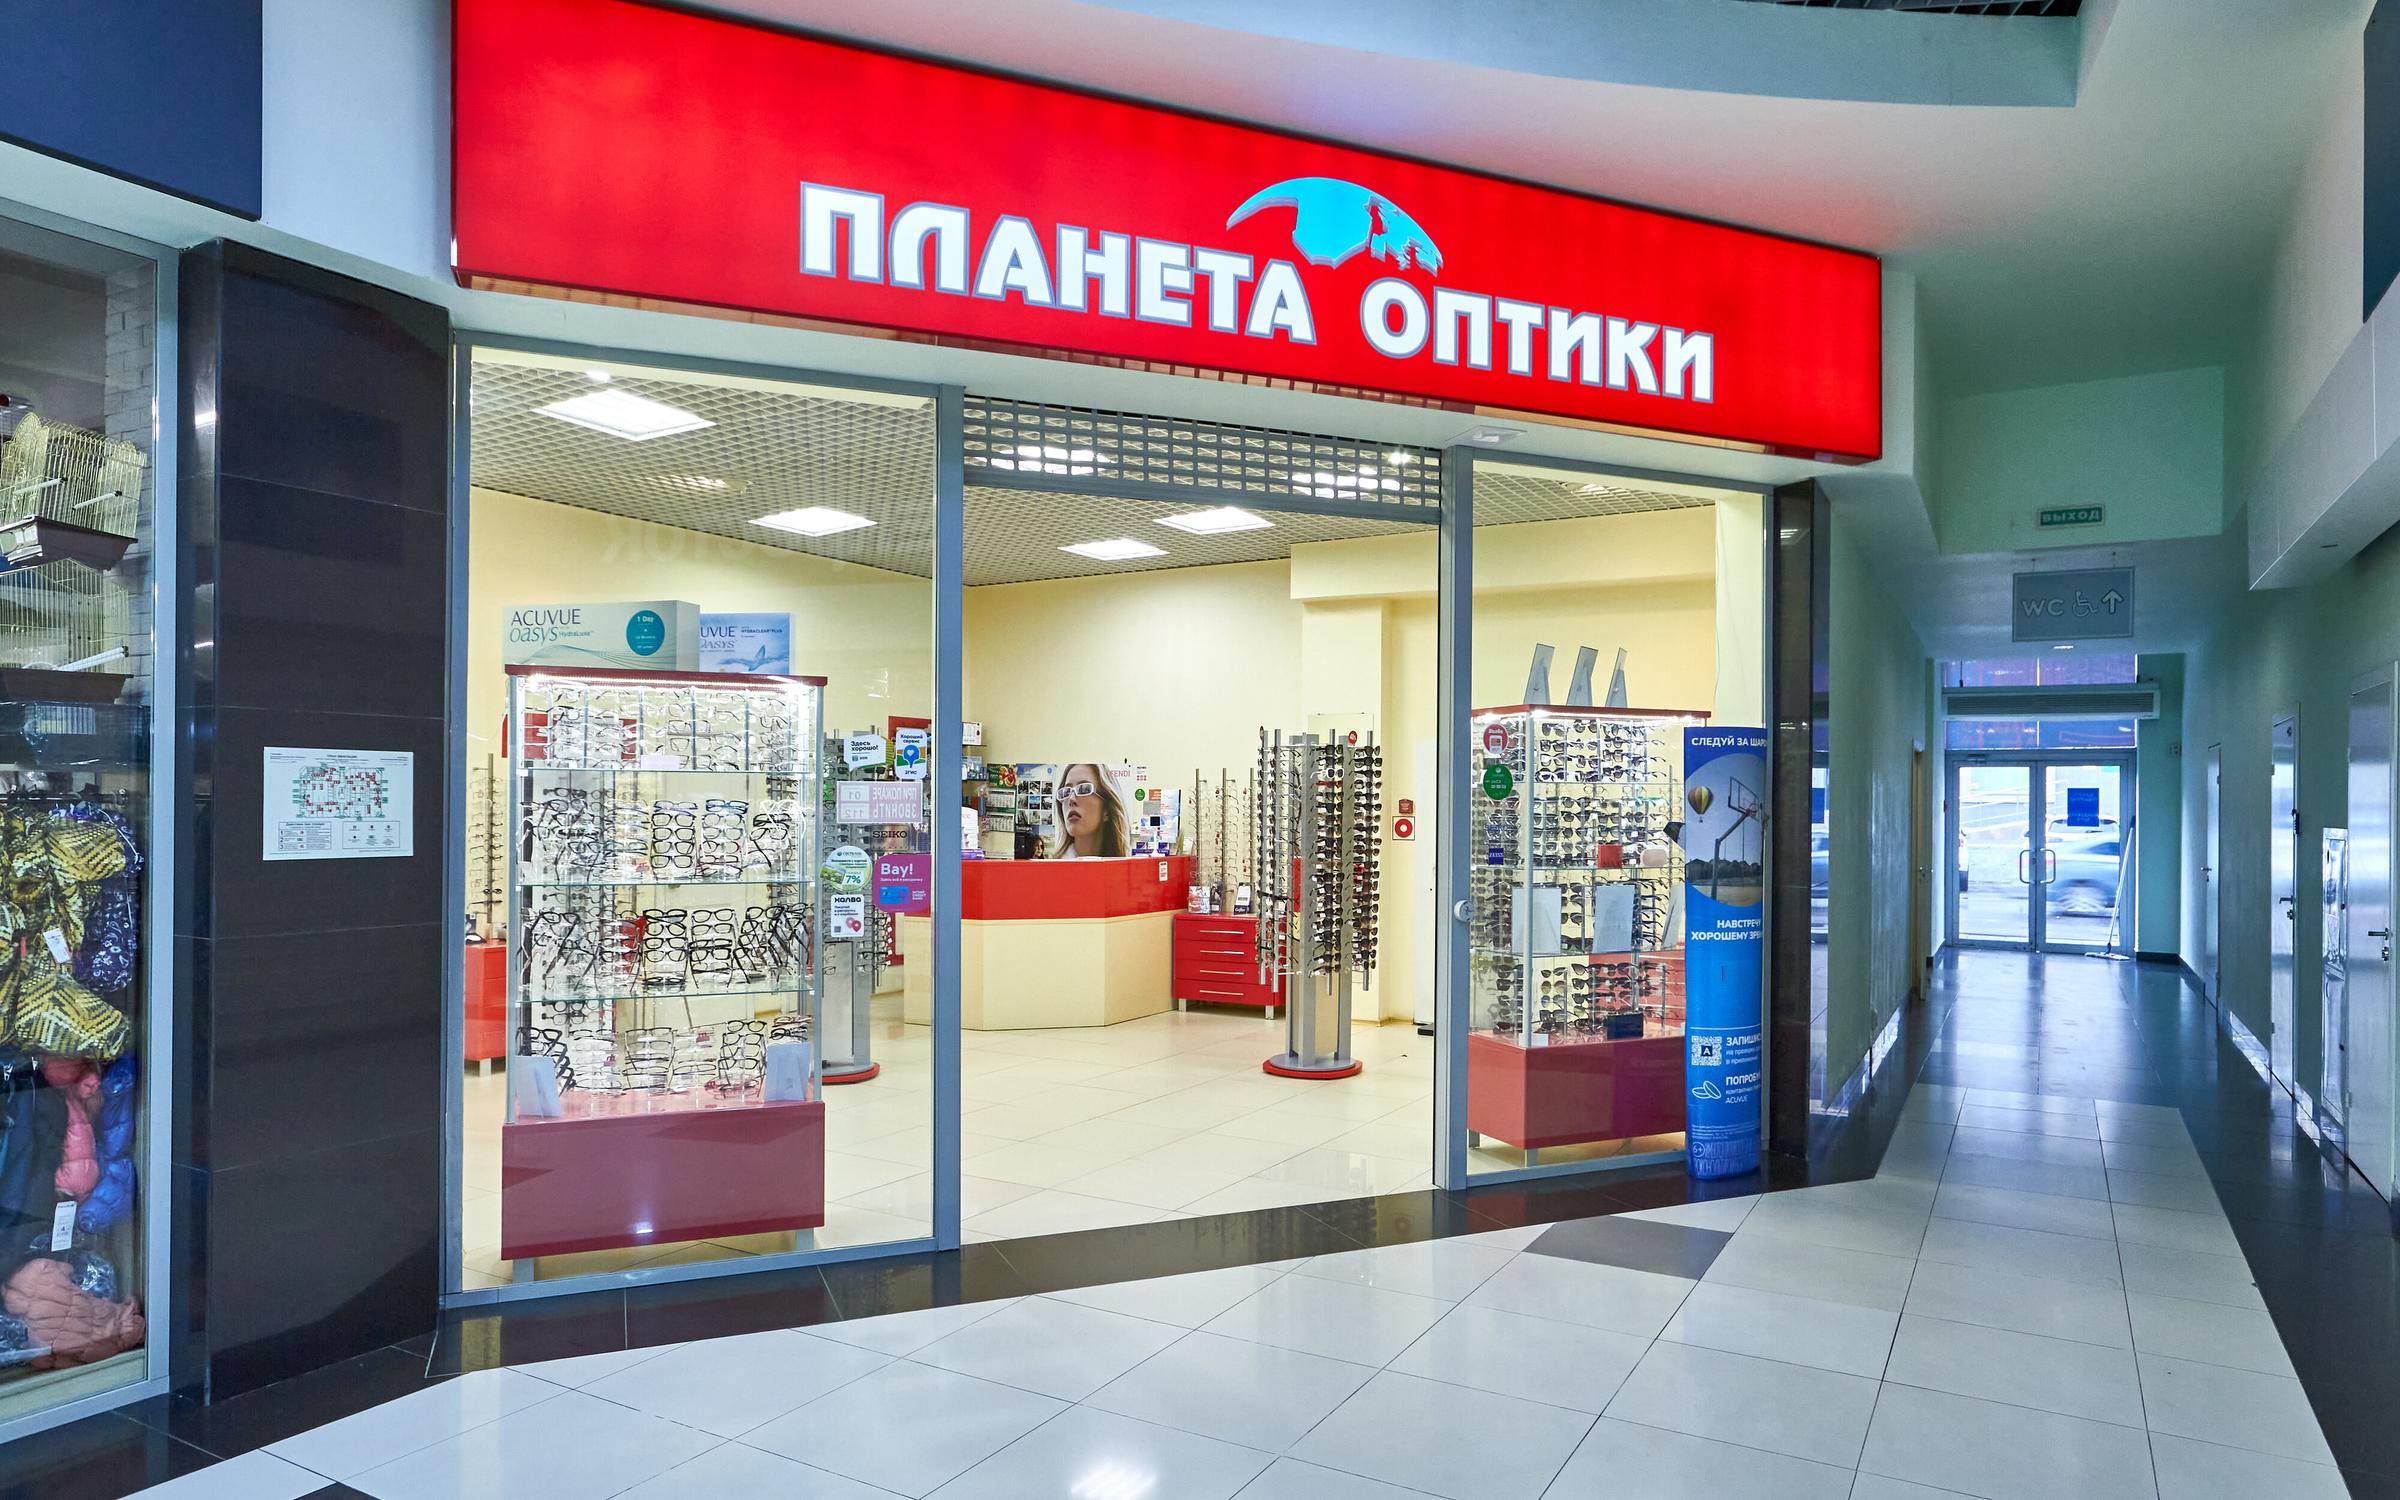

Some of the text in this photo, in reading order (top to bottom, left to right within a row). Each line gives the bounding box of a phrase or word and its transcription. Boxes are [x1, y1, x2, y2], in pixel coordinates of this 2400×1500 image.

[799, 181, 1714, 404] ПЛАНЕТА ОПТИКИ
[2042, 510, 2100, 523] ВЫХОД
[2022, 599, 2064, 617] WC
[511, 608, 582, 626] ACUVUE
[509, 626, 559, 646] oasys
[1691, 735, 1735, 748] СЛЕДУЙ
[1737, 737, 1749, 746] ЗА
[873, 830, 907, 838] SEIKO
[846, 875, 861, 884] 7%
[1691, 931, 1749, 941] ХОРОШЕМУ
